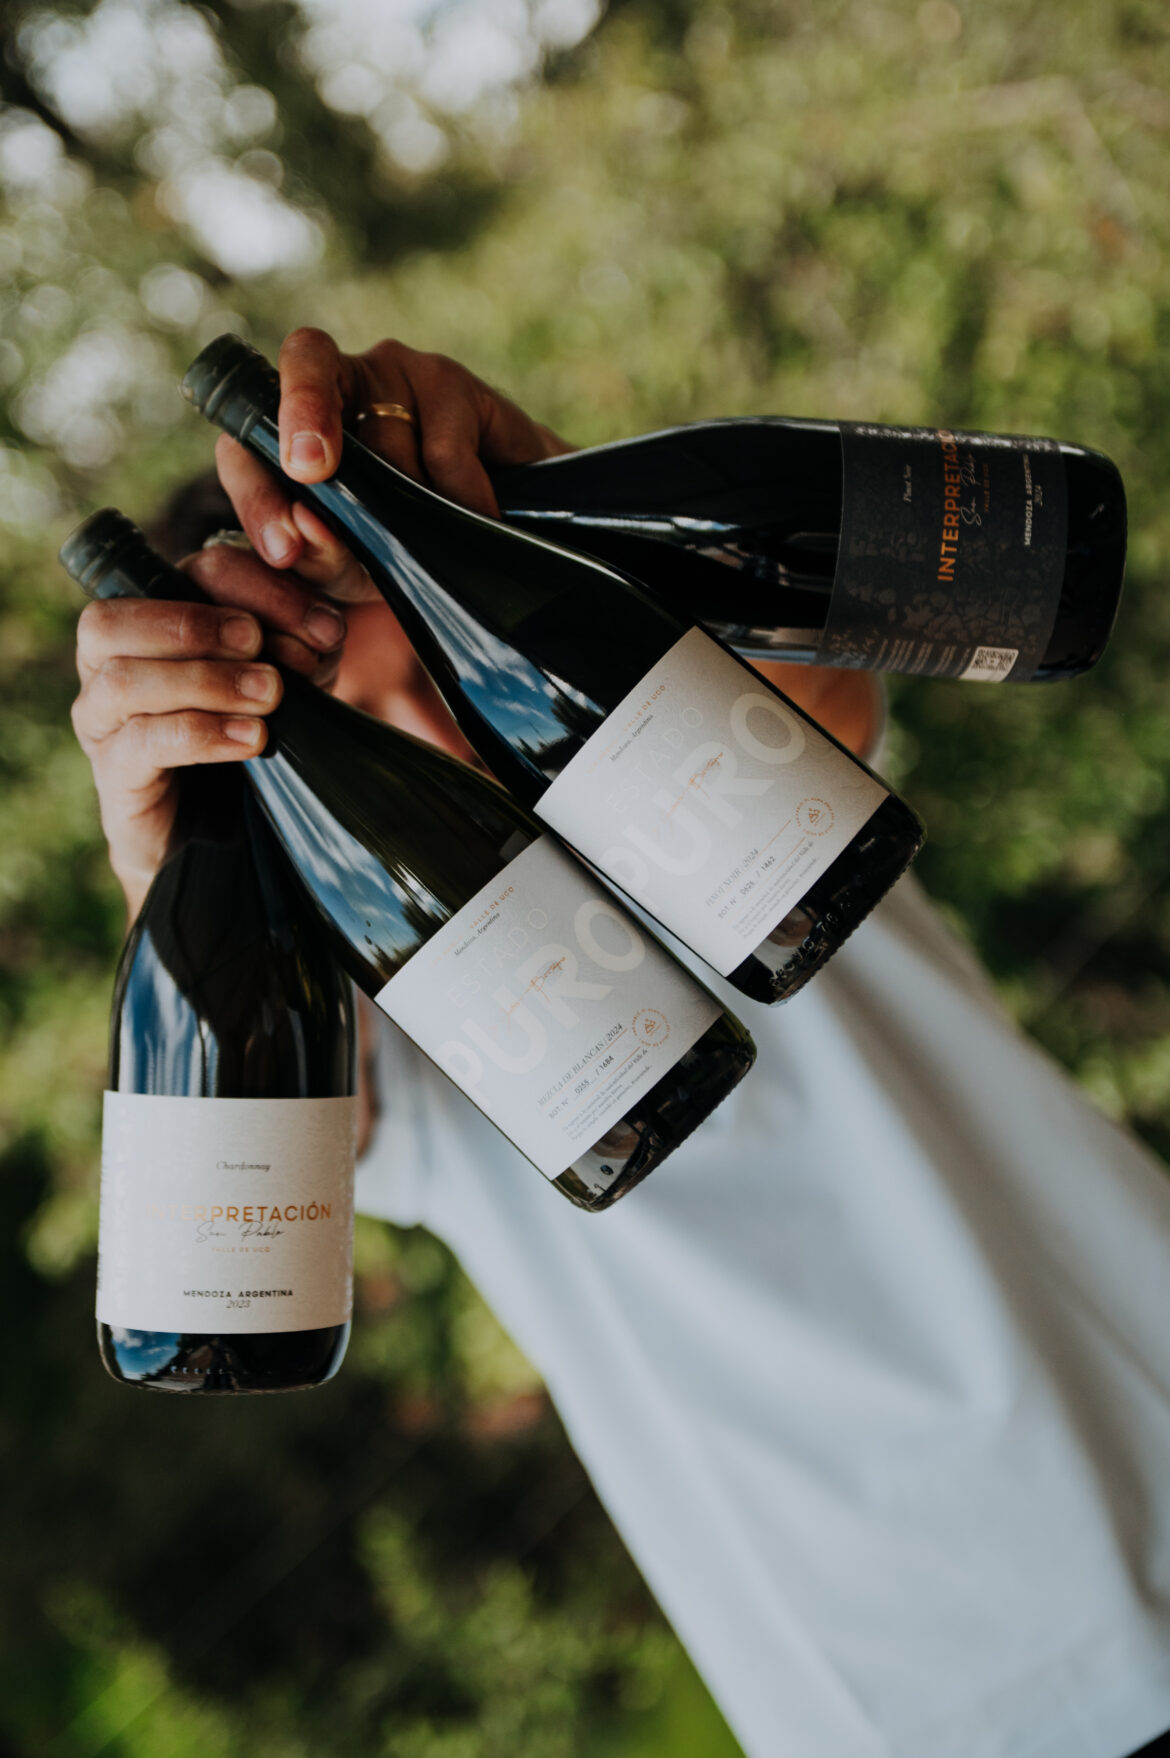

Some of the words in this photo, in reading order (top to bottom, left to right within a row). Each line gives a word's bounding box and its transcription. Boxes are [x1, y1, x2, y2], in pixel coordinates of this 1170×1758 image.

[1024, 499, 1033, 546] MENDOZA
[603, 1022, 623, 1041] 2024
[598, 1054, 614, 1070] 1684
[216, 1161, 271, 1172] Chardonnay
[183, 1290, 232, 1298] MENDOZA
[238, 1289, 293, 1298] ARGENTINA
